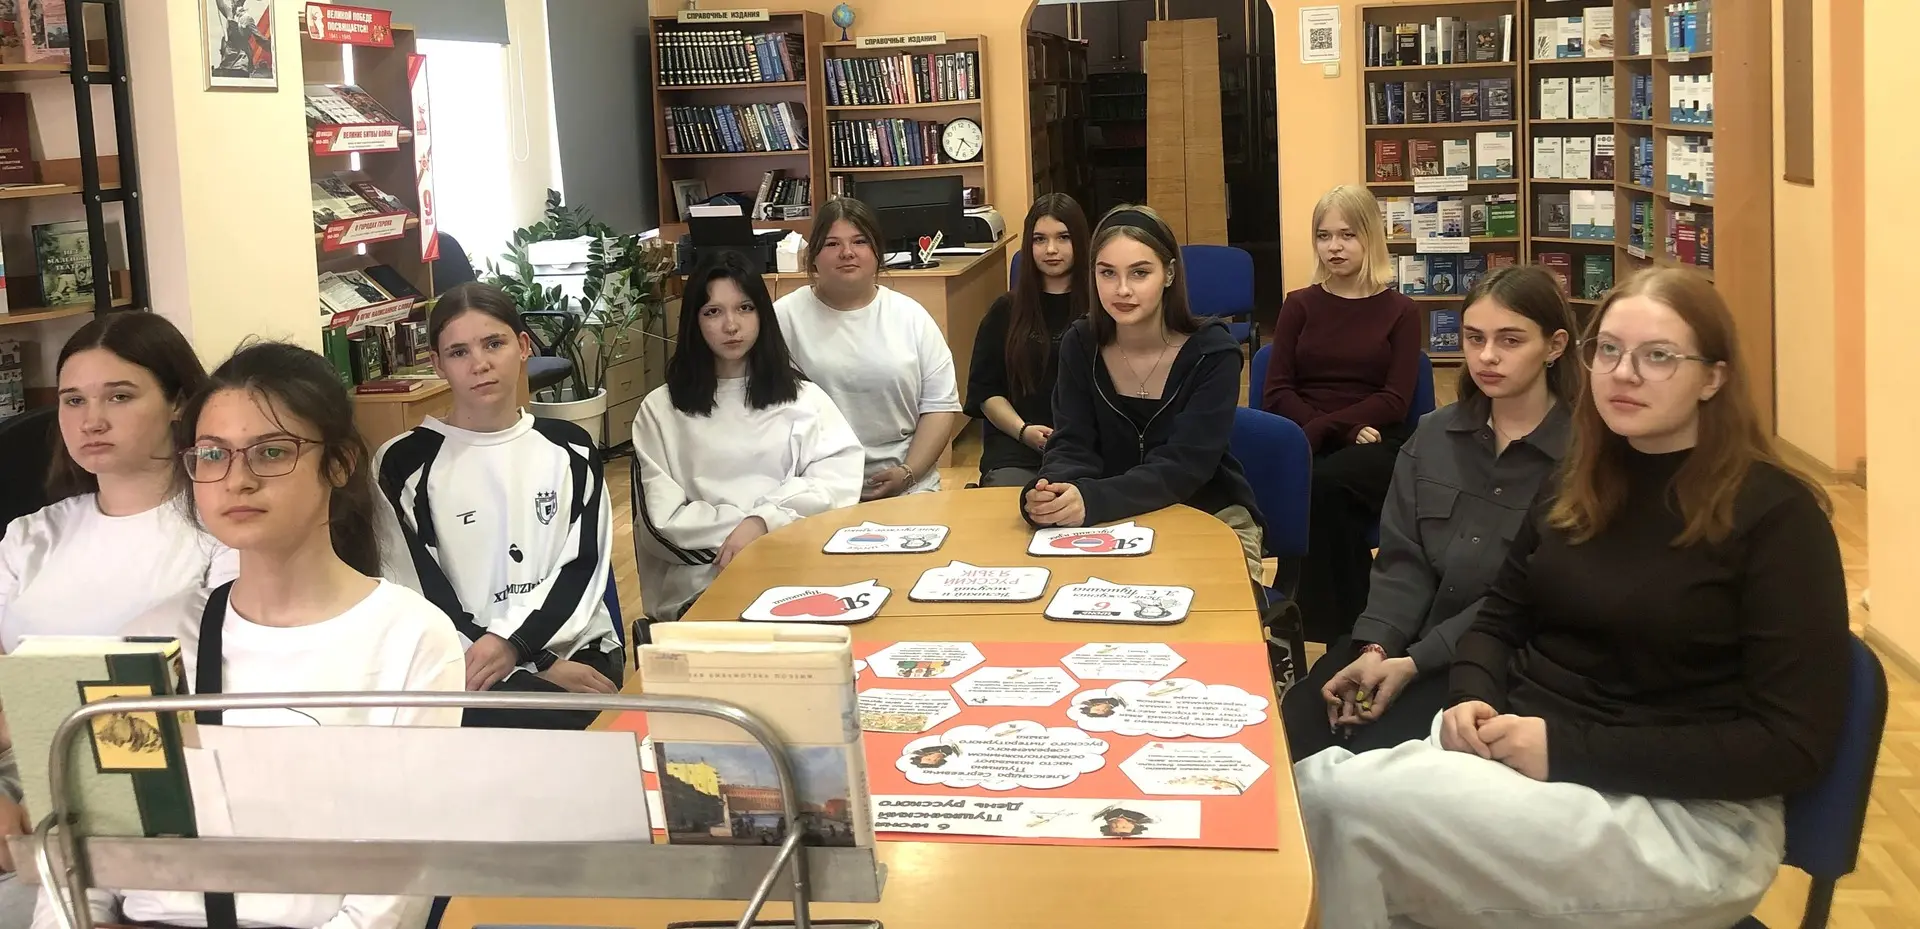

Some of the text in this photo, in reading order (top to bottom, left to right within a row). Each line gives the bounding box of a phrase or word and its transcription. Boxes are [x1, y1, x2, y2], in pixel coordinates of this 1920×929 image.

[326, 10, 372, 24] ВЕЛИКОЙ ПОБЕДЕ
[686, 12, 728, 20] СПРАВОЧНЫЕ
[327, 22, 369, 33] ПОСВЯЩАЕТСЯ!
[864, 35, 937, 46] СПРАВОЧНЫЕ ИЗДАНИЯ
[363, 130, 378, 138] БИТВЫ
[423, 190, 432, 216] 9
[1112, 538, 1143, 550] Я
[944, 578, 1020, 586] РУССКИЙ
[1072, 587, 1138, 596] Пушкина
[837, 593, 870, 610] Я
[1094, 602, 1110, 610] 6
[958, 738, 1103, 747] русского литературного
[922, 770, 1070, 780] Александра Сергеевича
[878, 800, 1023, 810] День русского
[878, 812, 1003, 822] Пушкинский
